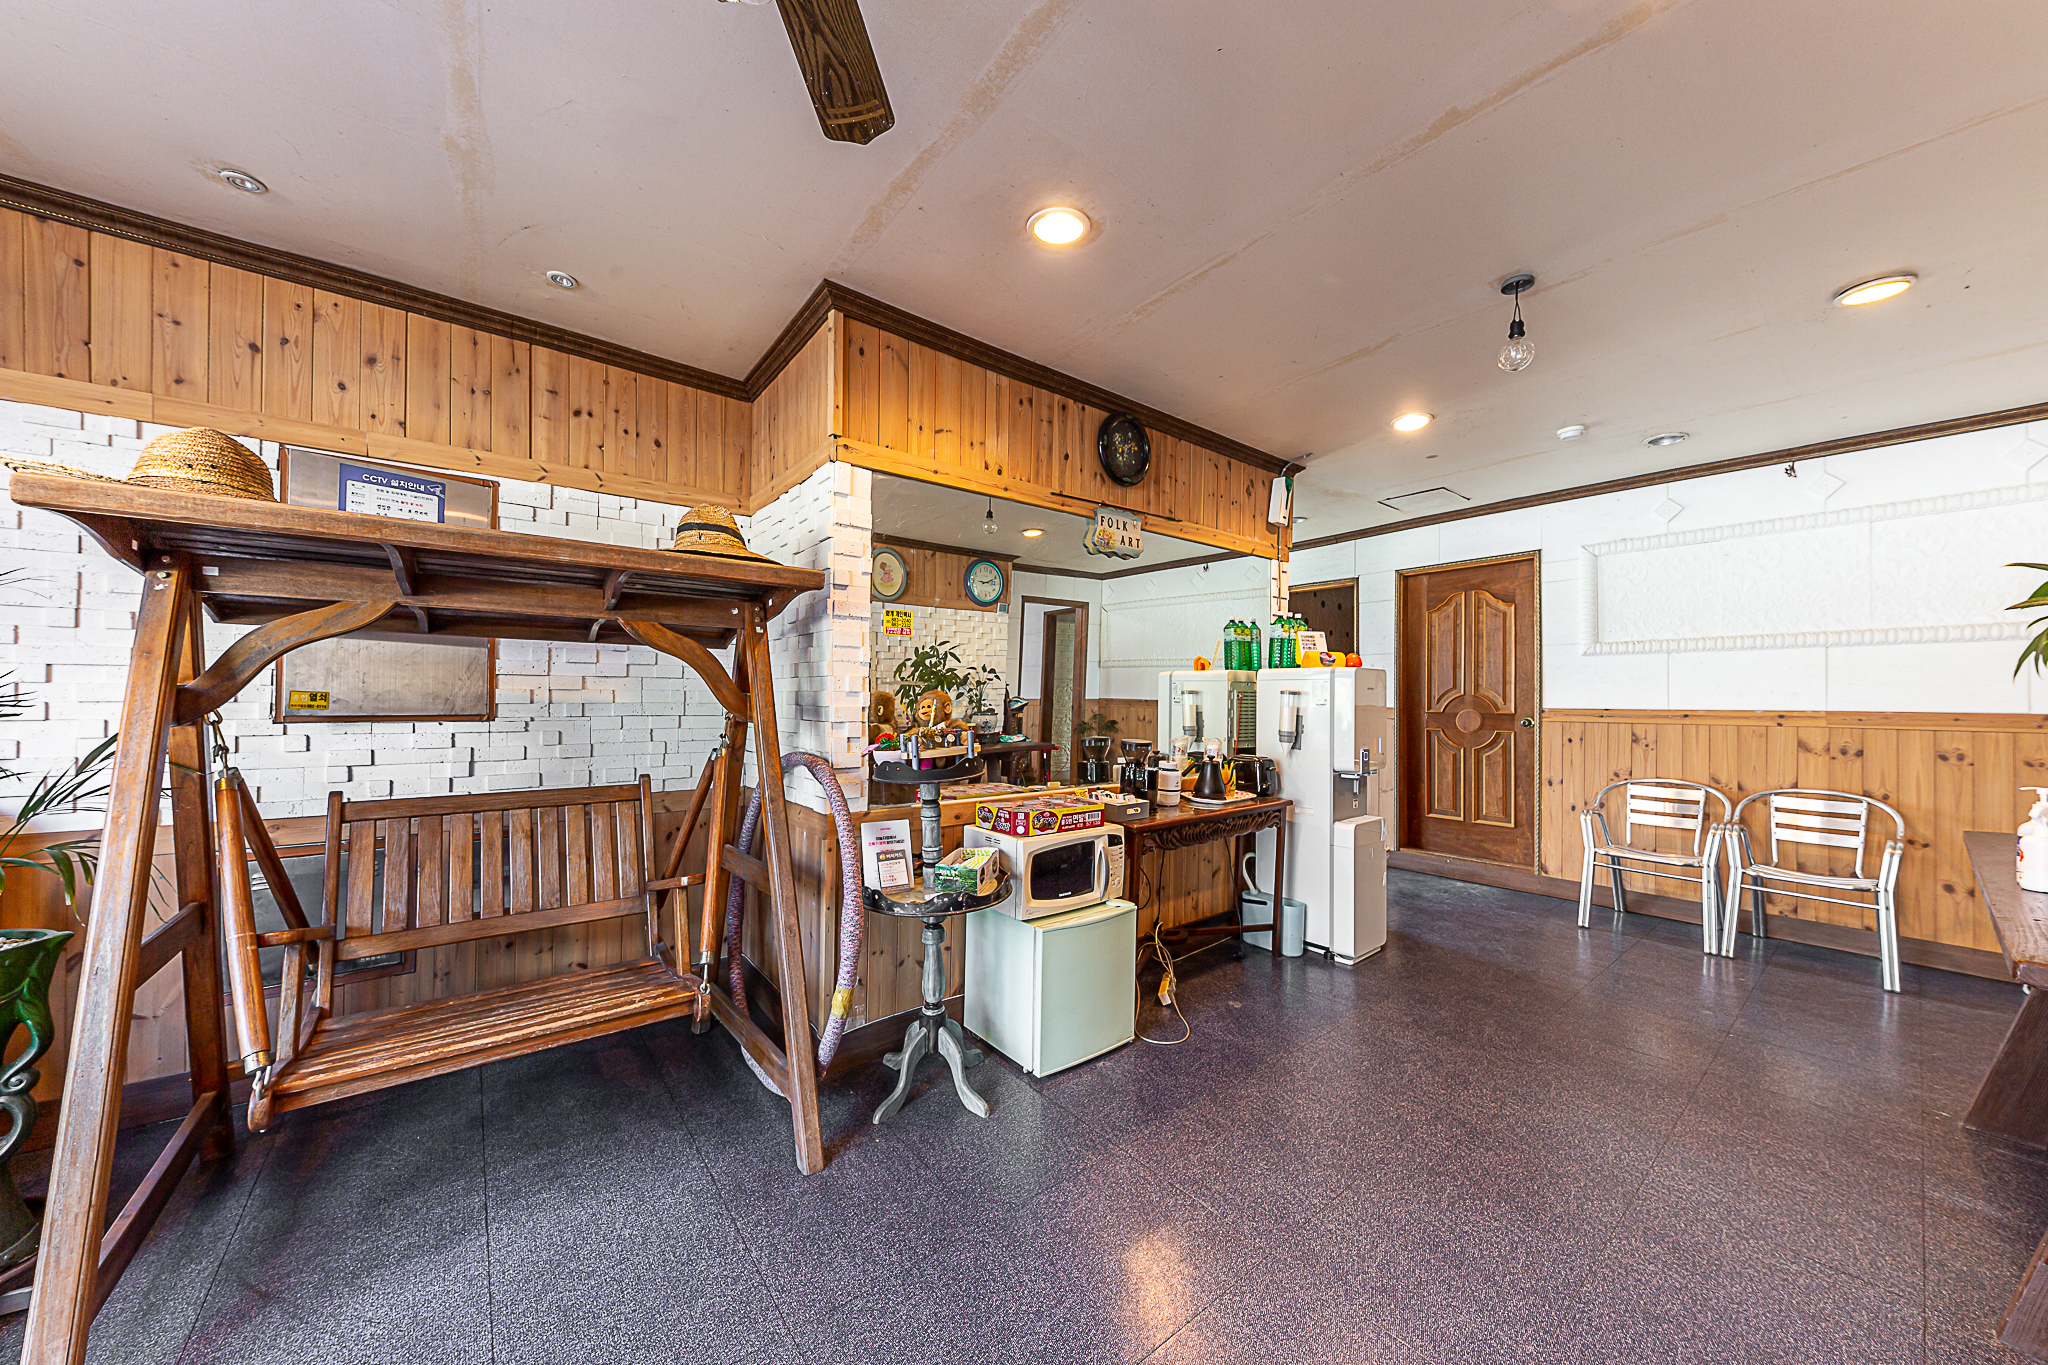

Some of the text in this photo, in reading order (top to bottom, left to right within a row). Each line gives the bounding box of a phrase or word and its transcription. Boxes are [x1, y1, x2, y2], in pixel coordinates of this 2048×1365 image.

[362, 474, 425, 492] CCTV 설치안내
[1100, 515, 1128, 532] FOLK
[1119, 535, 1141, 549] ART
[309, 693, 327, 702] 열쇠
